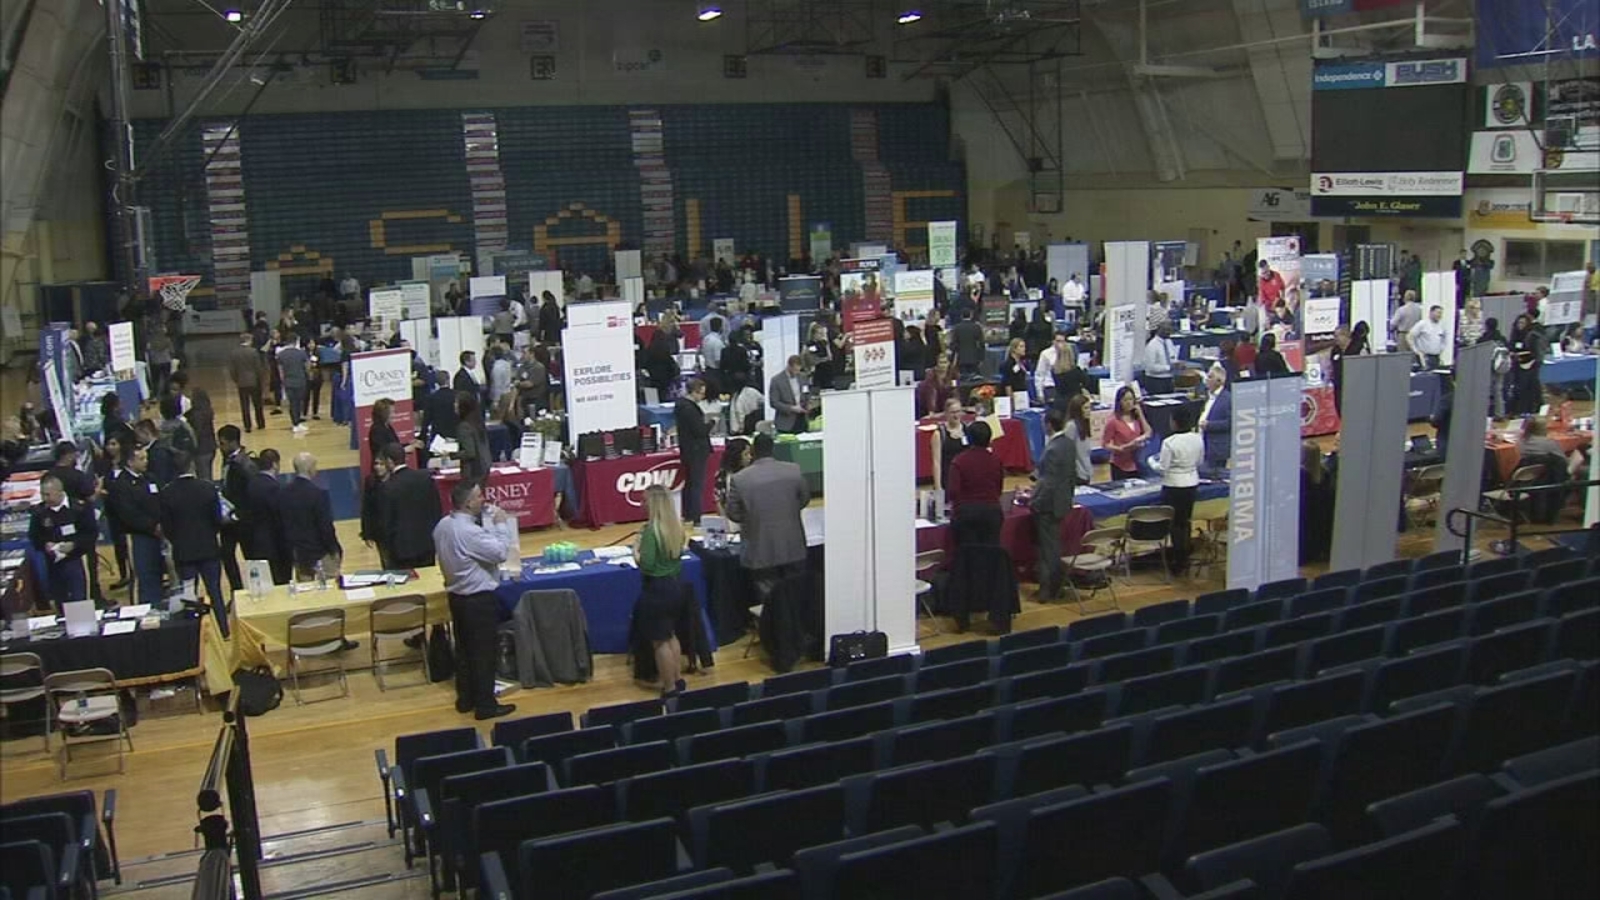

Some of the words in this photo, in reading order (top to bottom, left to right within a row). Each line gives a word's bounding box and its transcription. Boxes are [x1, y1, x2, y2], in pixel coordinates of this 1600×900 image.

[1572, 34, 1596, 51] LA
[1314, 71, 1372, 83] Independence
[364, 369, 405, 387] CARNEY
[574, 365, 612, 376] EXPLORE
[574, 371, 632, 386] POSSIBILITIES
[616, 469, 679, 493] CDW
